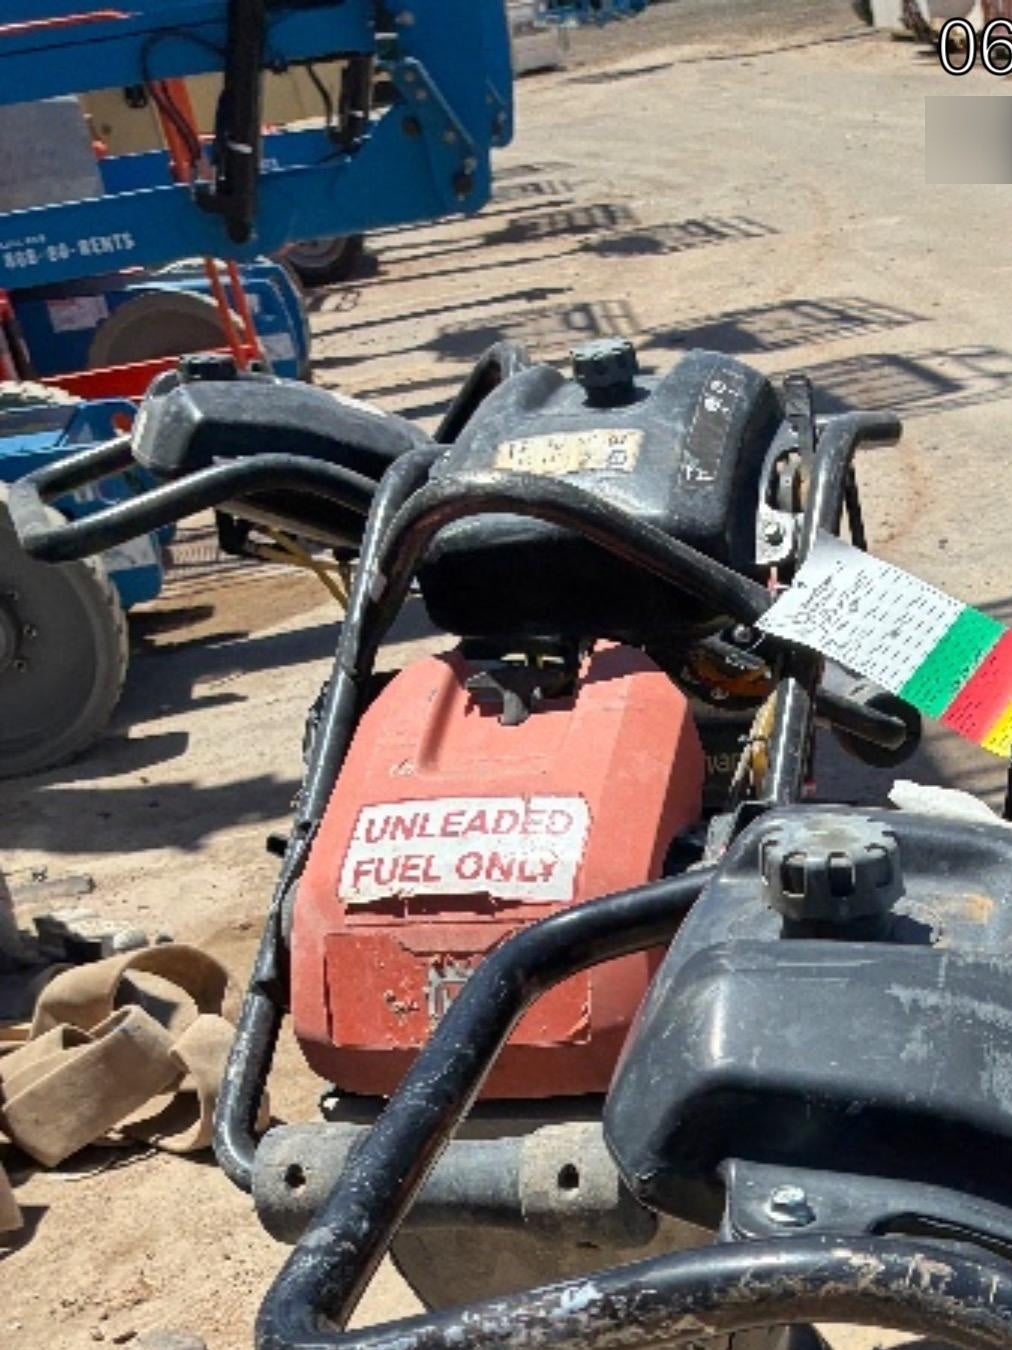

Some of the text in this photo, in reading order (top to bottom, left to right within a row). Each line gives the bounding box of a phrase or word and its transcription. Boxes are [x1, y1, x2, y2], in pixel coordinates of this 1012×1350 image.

[364, 808, 574, 844] UNLEADED
[353, 851, 559, 889] FUEL ONLY
